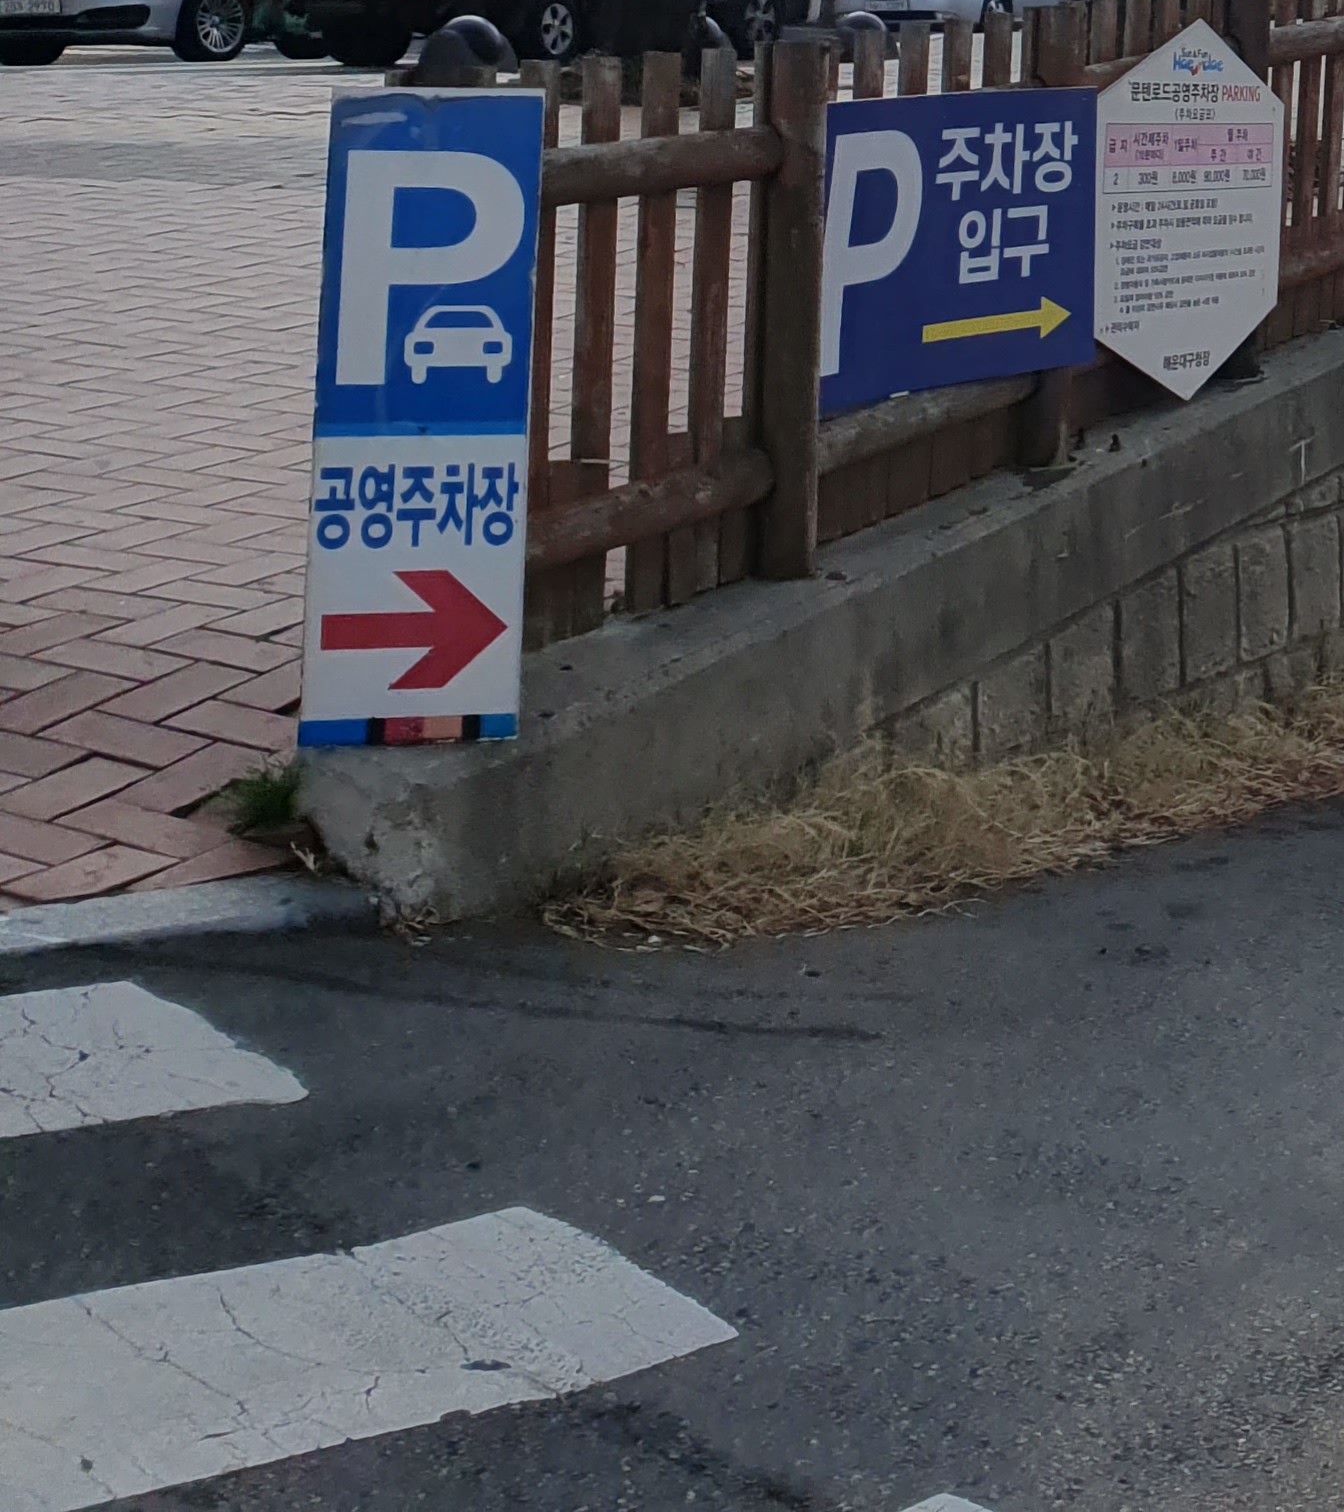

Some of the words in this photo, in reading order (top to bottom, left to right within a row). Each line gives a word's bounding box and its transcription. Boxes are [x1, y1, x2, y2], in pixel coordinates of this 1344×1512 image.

[1221, 85, 1261, 102] PARKING
[935, 120, 1079, 202] 주차장
[1113, 172, 1119, 186] 2
[335, 149, 526, 386] P
[819, 129, 923, 378] P
[958, 204, 1051, 285] 입구
[1163, 350, 1211, 371] 해운대구청장
[313, 462, 520, 550] 공영주차장
